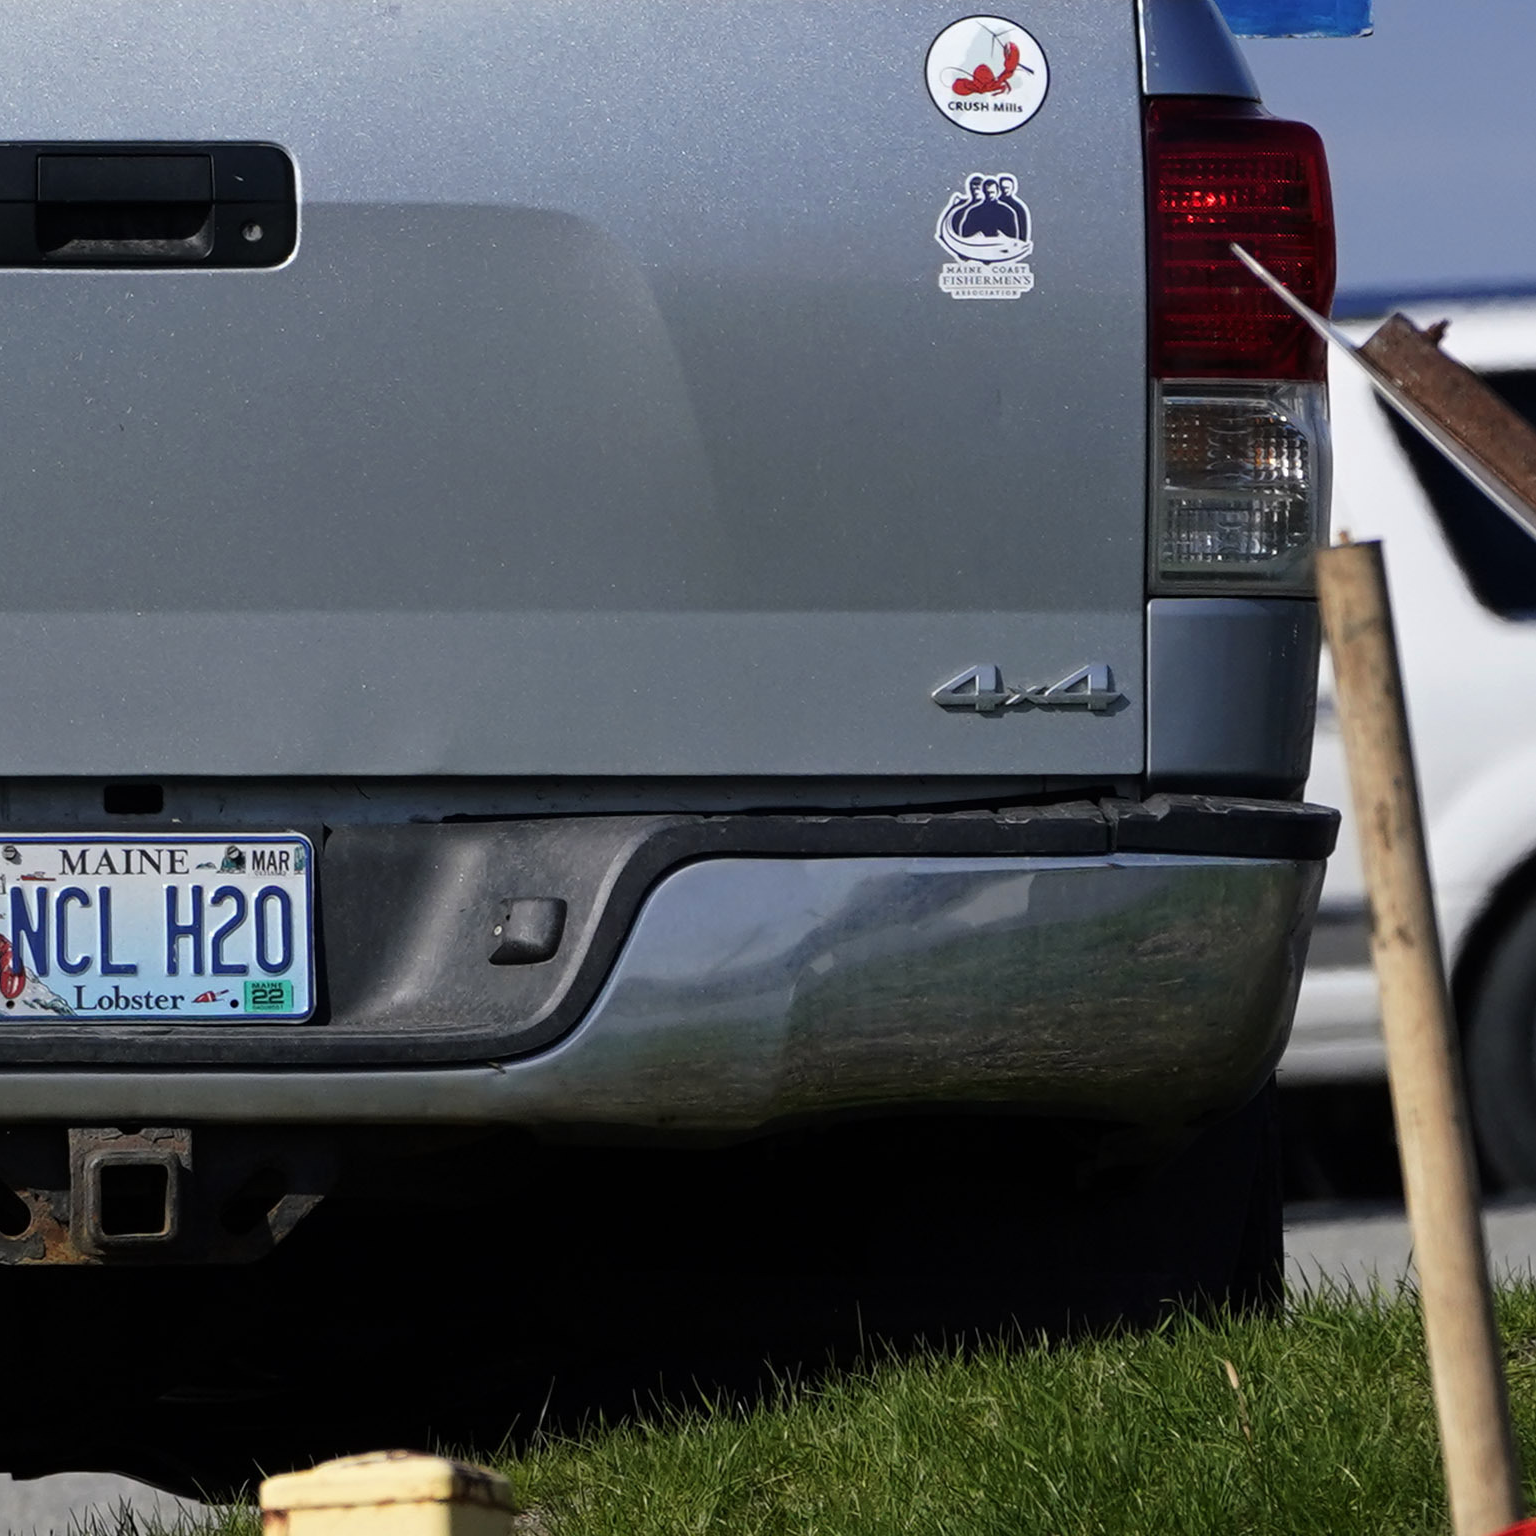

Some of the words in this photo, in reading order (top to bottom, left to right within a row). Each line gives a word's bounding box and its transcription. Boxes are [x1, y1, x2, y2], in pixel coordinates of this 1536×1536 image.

[947, 100, 990, 112] CRUSH
[993, 102, 1023, 113] Mills
[946, 265, 983, 274] MAINE
[991, 265, 1026, 274] COAST
[57, 848, 190, 876] MAINE
[252, 849, 291, 871] MAR
[8, 884, 138, 977] NCL
[73, 984, 185, 1011] Lobster
[251, 988, 285, 1005] 22
